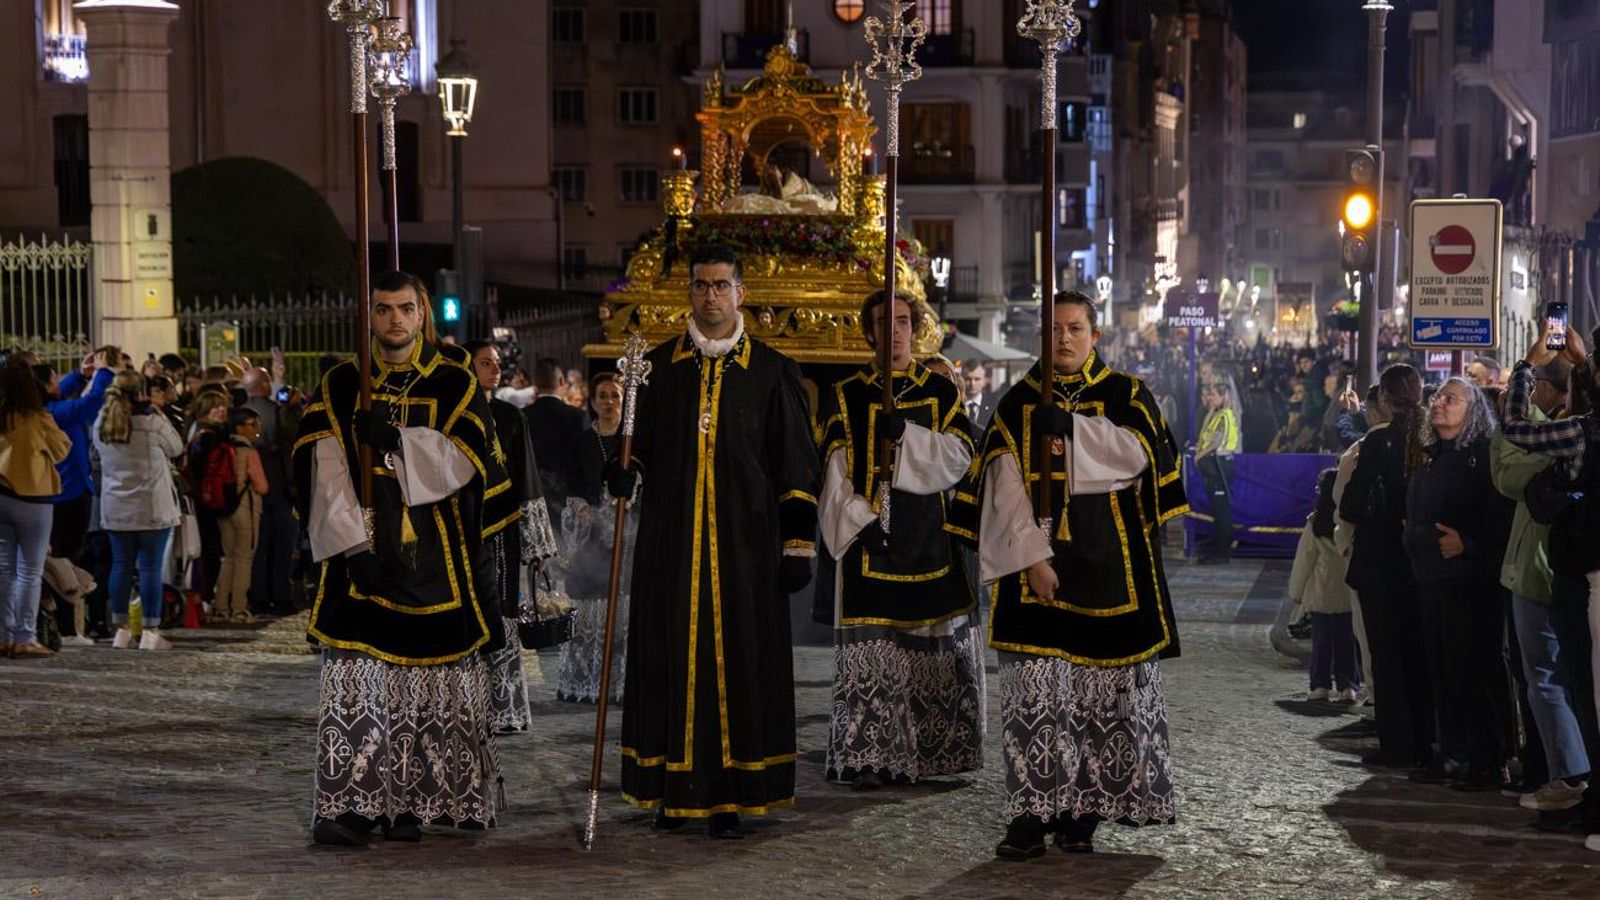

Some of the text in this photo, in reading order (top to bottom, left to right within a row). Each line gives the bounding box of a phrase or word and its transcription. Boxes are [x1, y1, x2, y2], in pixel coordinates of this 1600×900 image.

[1415, 276, 1443, 285] EXCEPTO
[1418, 297, 1440, 306] CARGA
[1179, 306, 1205, 317] PASO
[1168, 316, 1217, 328] PEATONAL
[1446, 327, 1488, 335] CONTROLADO
